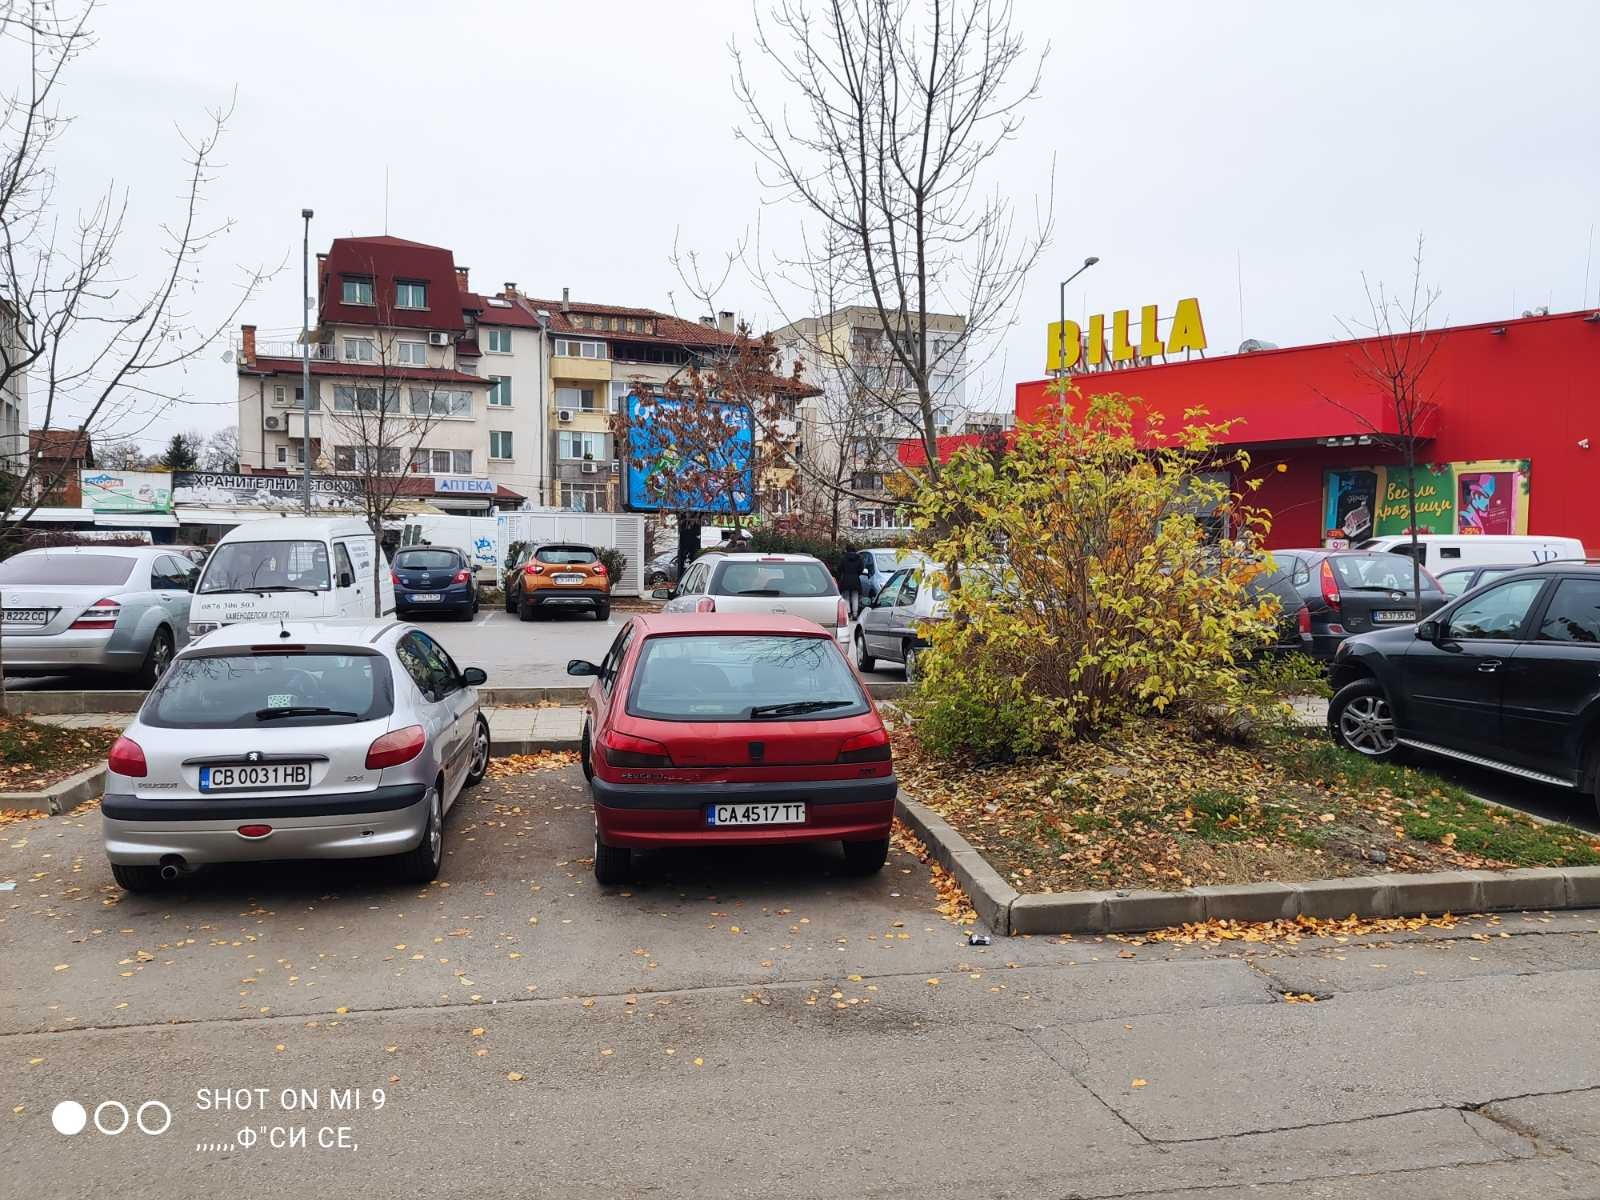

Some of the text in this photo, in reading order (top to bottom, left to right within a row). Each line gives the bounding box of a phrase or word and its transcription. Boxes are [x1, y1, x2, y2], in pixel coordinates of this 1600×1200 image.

[1046, 297, 1208, 374] BILLA
[194, 474, 297, 492] ХРАНИТЕЛНИ
[440, 479, 493, 492] АПТЕКА
[1387, 482, 1437, 500] Весли
